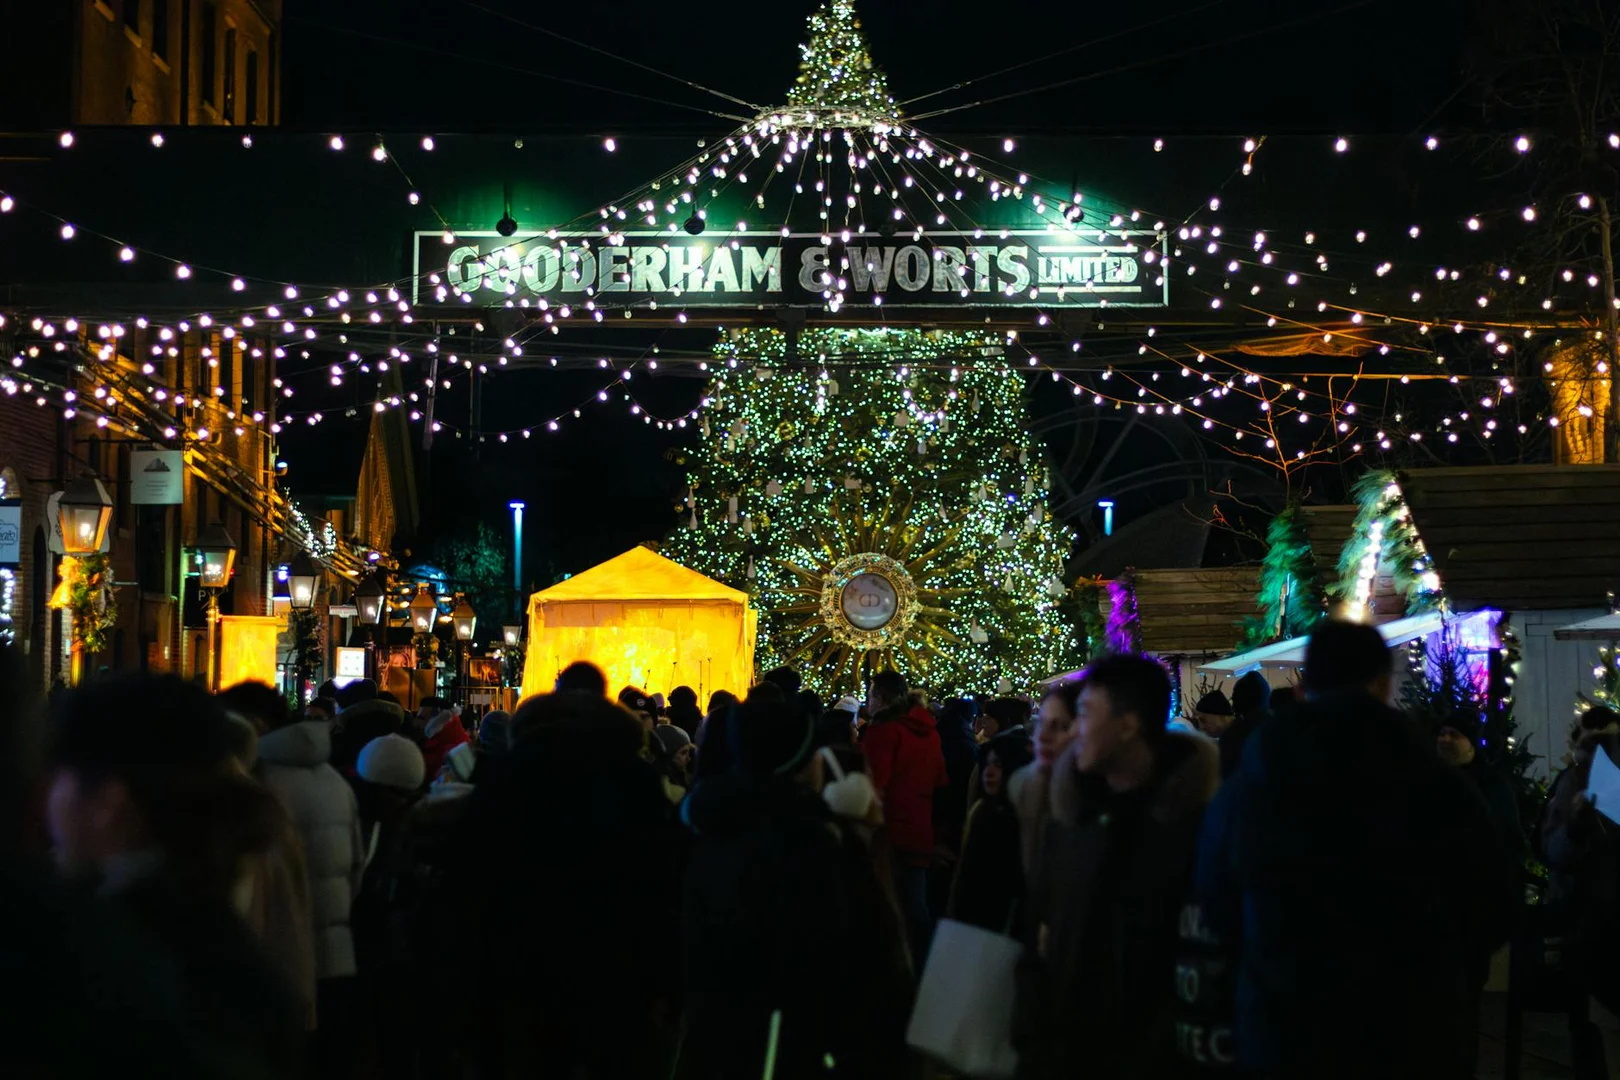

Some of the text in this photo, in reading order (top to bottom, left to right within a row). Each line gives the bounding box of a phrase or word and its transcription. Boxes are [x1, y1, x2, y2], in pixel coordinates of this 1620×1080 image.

[447, 245, 1029, 294] GOODERHAM & WORTS
[1037, 256, 1138, 284] LIMITED
